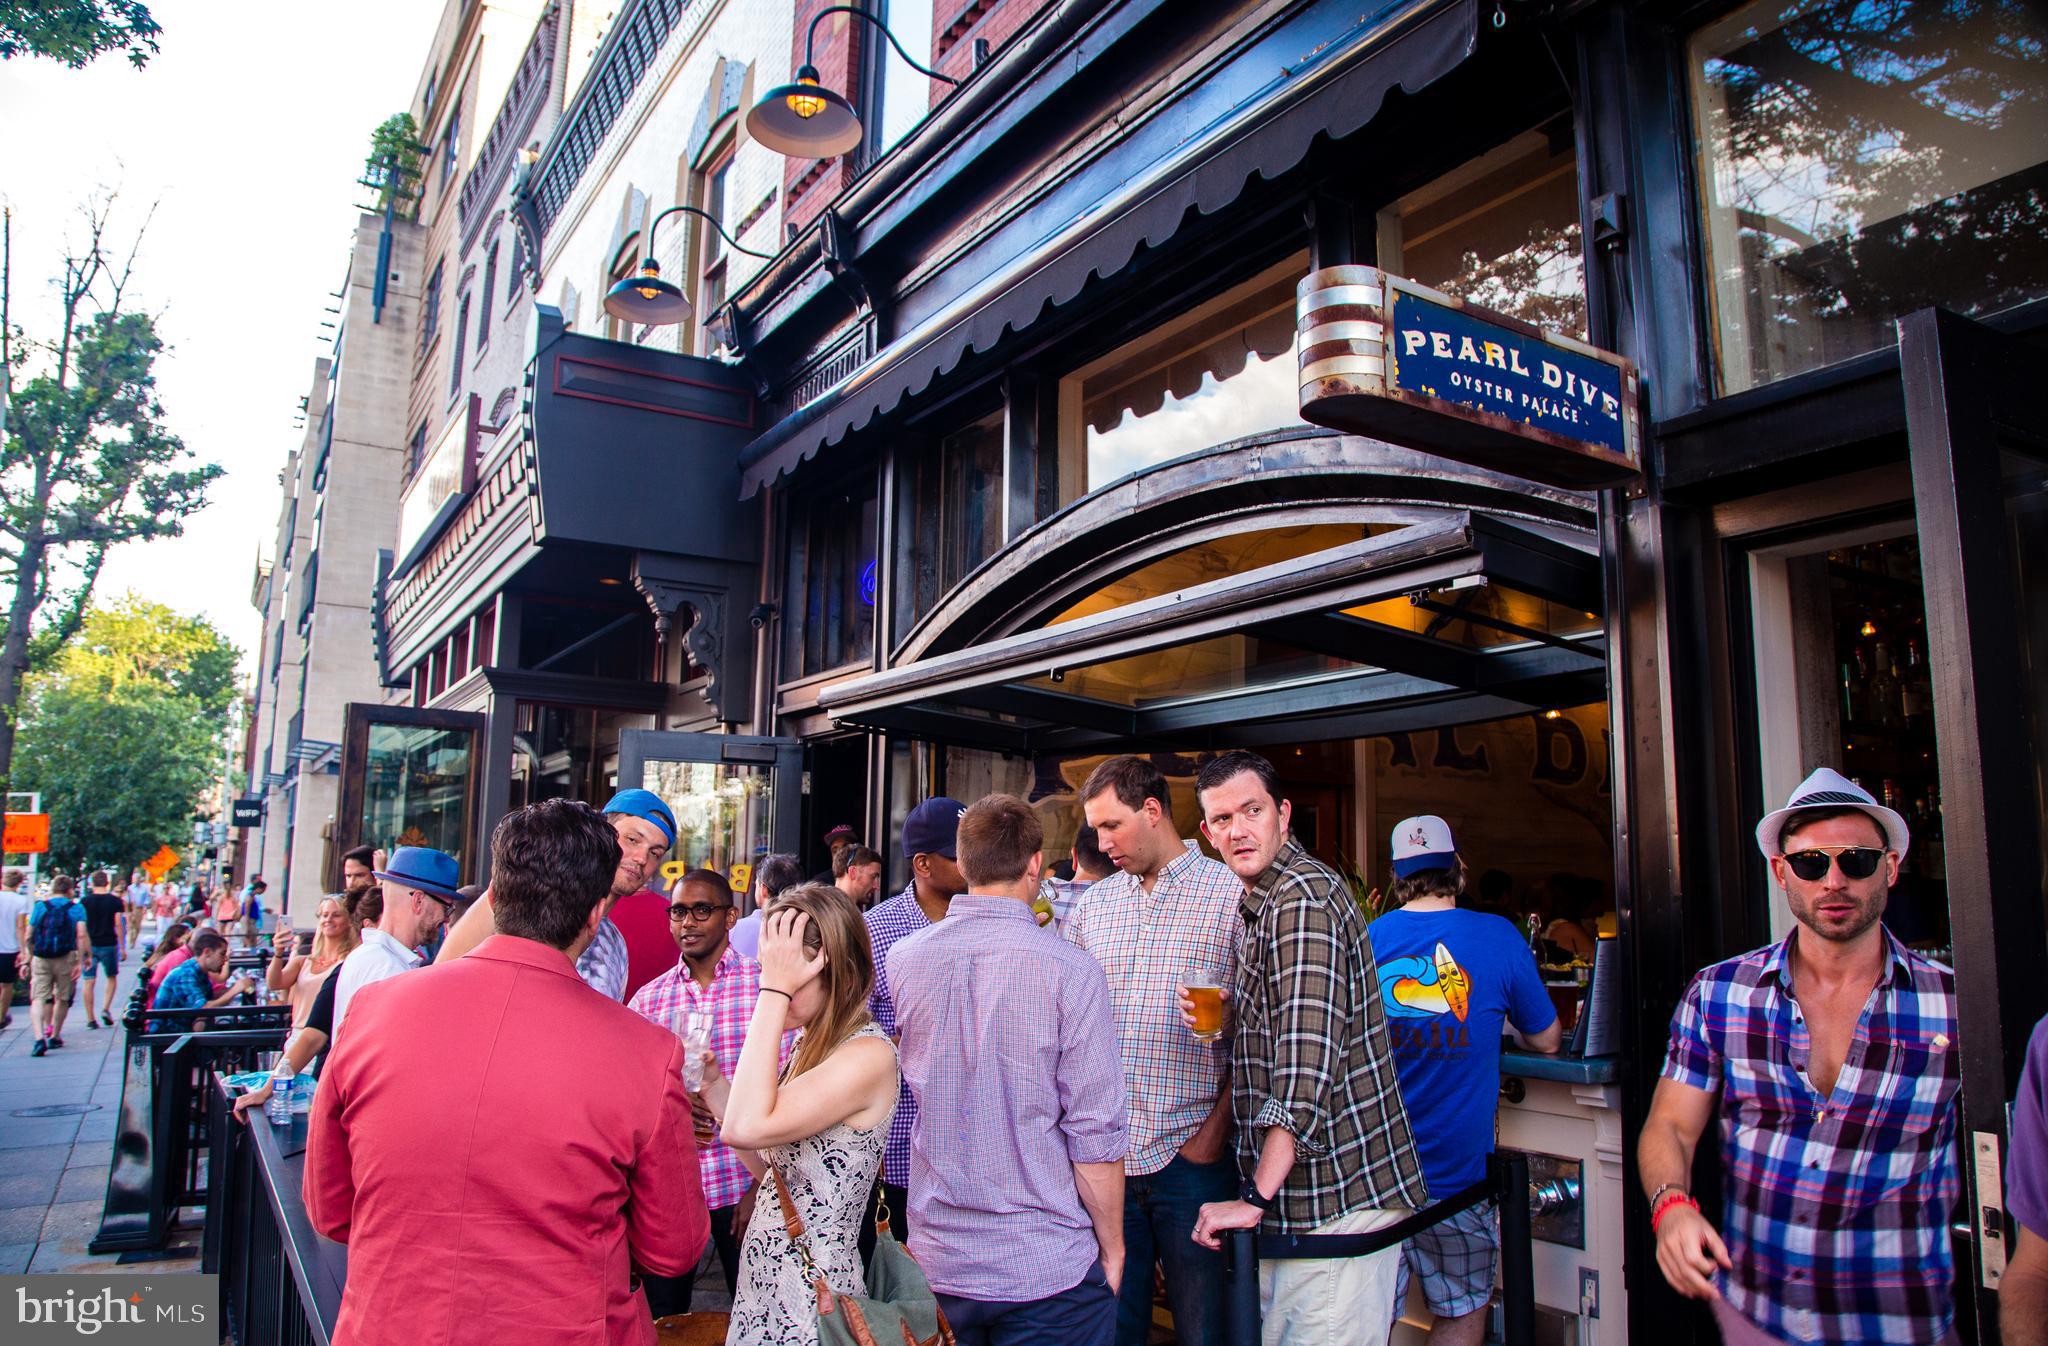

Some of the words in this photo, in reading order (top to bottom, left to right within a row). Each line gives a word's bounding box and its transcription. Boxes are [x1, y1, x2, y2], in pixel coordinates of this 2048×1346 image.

[1402, 329, 1529, 377] PEARL
[1542, 360, 1620, 422] DIVE
[1451, 371, 1514, 404] OYSTER
[1522, 393, 1579, 424] PALACE
